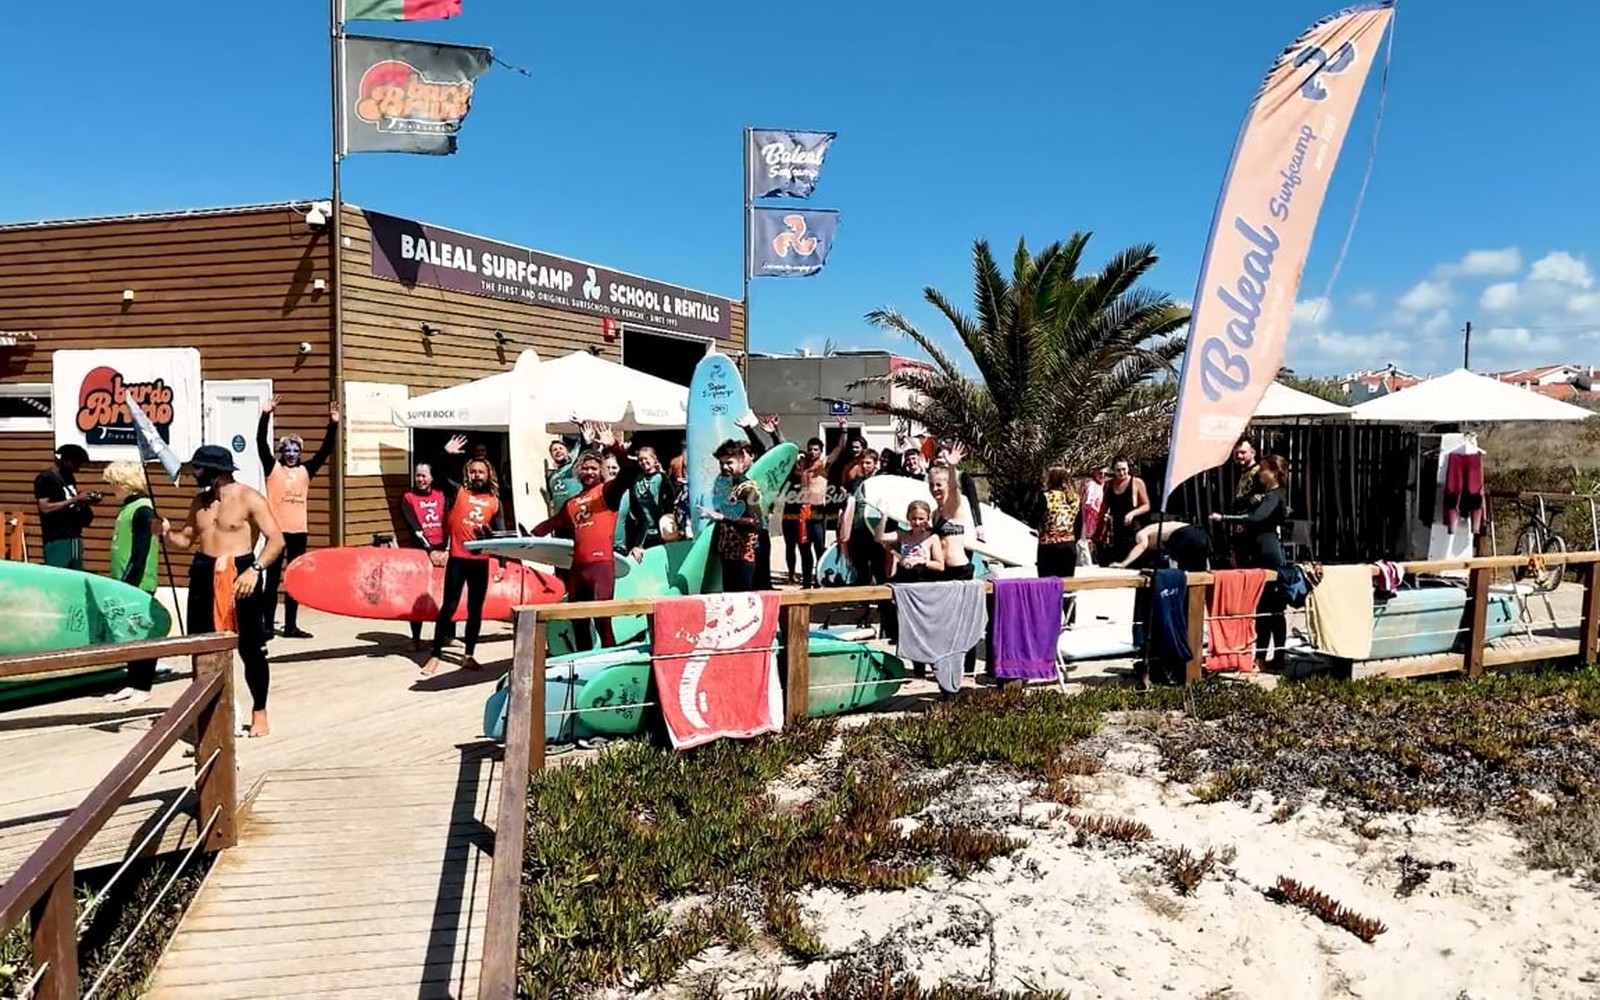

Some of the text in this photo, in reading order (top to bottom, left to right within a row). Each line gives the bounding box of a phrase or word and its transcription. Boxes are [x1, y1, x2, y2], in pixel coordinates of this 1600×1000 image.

[761, 142, 824, 165] Baleal
[1200, 216, 1280, 402] Baleal
[1269, 124, 1317, 222] Surfcamp
[401, 234, 720, 323] BALEAL SURFCAMP SCHOOL & RENTALS
[481, 280, 495, 291] THE
[497, 284, 518, 296] FIRST
[520, 289, 536, 300] AND
[538, 292, 569, 306] ORIGINAL
[407, 410, 456, 420] SUPER BOCK
